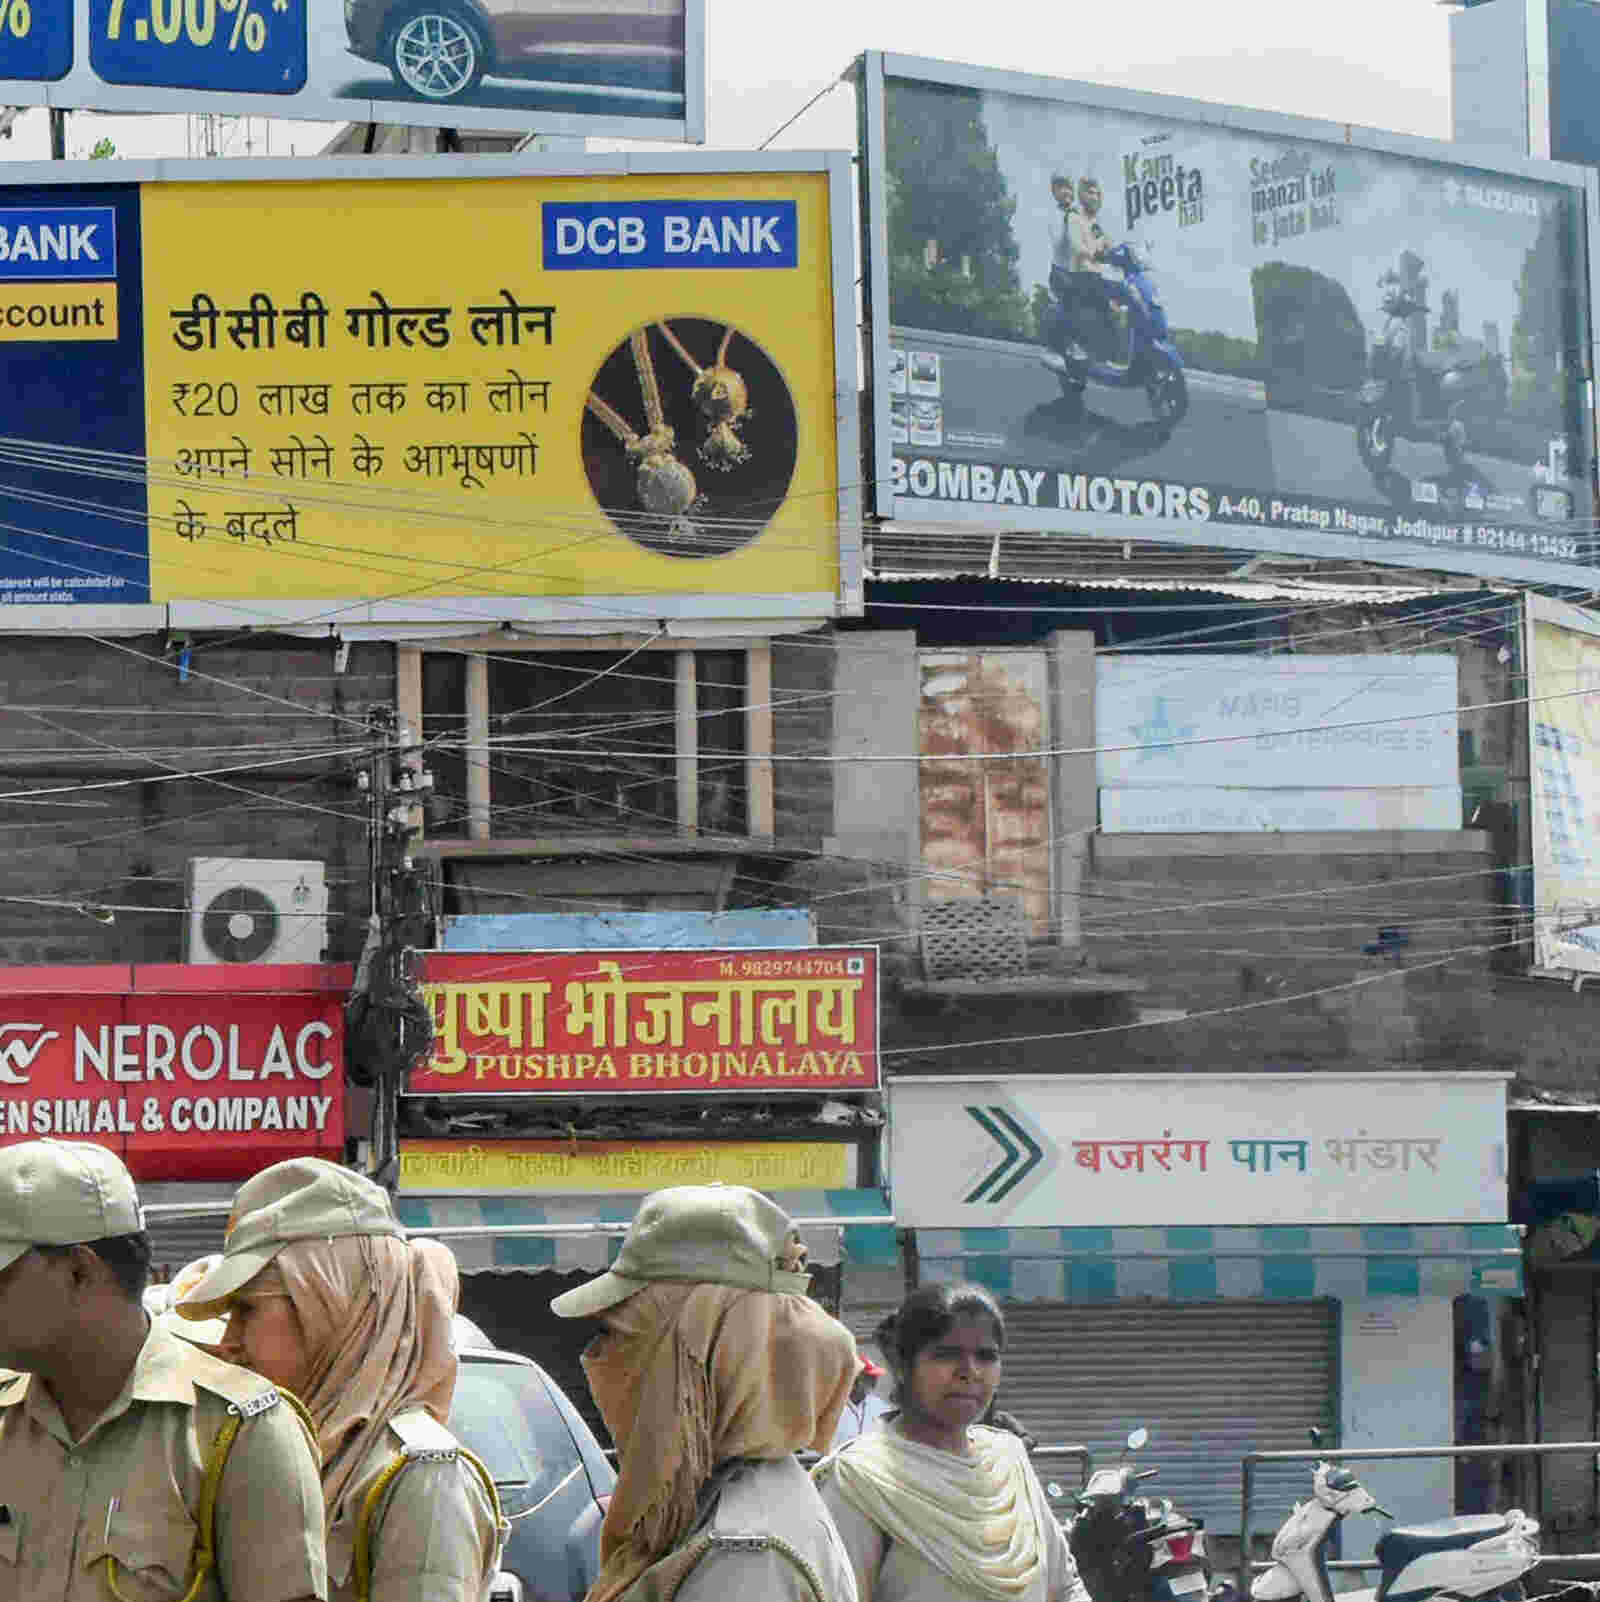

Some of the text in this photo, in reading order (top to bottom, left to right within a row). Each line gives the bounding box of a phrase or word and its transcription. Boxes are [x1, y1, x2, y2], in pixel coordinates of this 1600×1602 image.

[1125, 166, 1203, 230] peeta
[556, 215, 782, 256] DCB BANK
[170, 288, 557, 350] डीसीबी गोल्ड लोन
[172, 369, 552, 417] ₹20 लाख तक का लोन
[175, 432, 541, 489] अपने सोने के आभूषणों
[173, 499, 301, 545] के बदले
[891, 457, 1048, 506] BOMBAY
[1057, 473, 1210, 523] MOTORS
[1217, 494, 1266, 525] A-40,
[1271, 500, 1331, 529] Pratap
[1334, 507, 1388, 537] Nagar,
[1392, 515, 1462, 546] Jodhpur
[418, 960, 864, 1074] पुष्पा भोजनालय
[73, 1021, 334, 1082] NEROLAC
[474, 1051, 865, 1083] PUSHPA BHOJNALAYA
[142, 1096, 165, 1132] &
[171, 1095, 333, 1131] COMPANY
[1071, 1128, 1442, 1173] बजरंग पान भंडार
